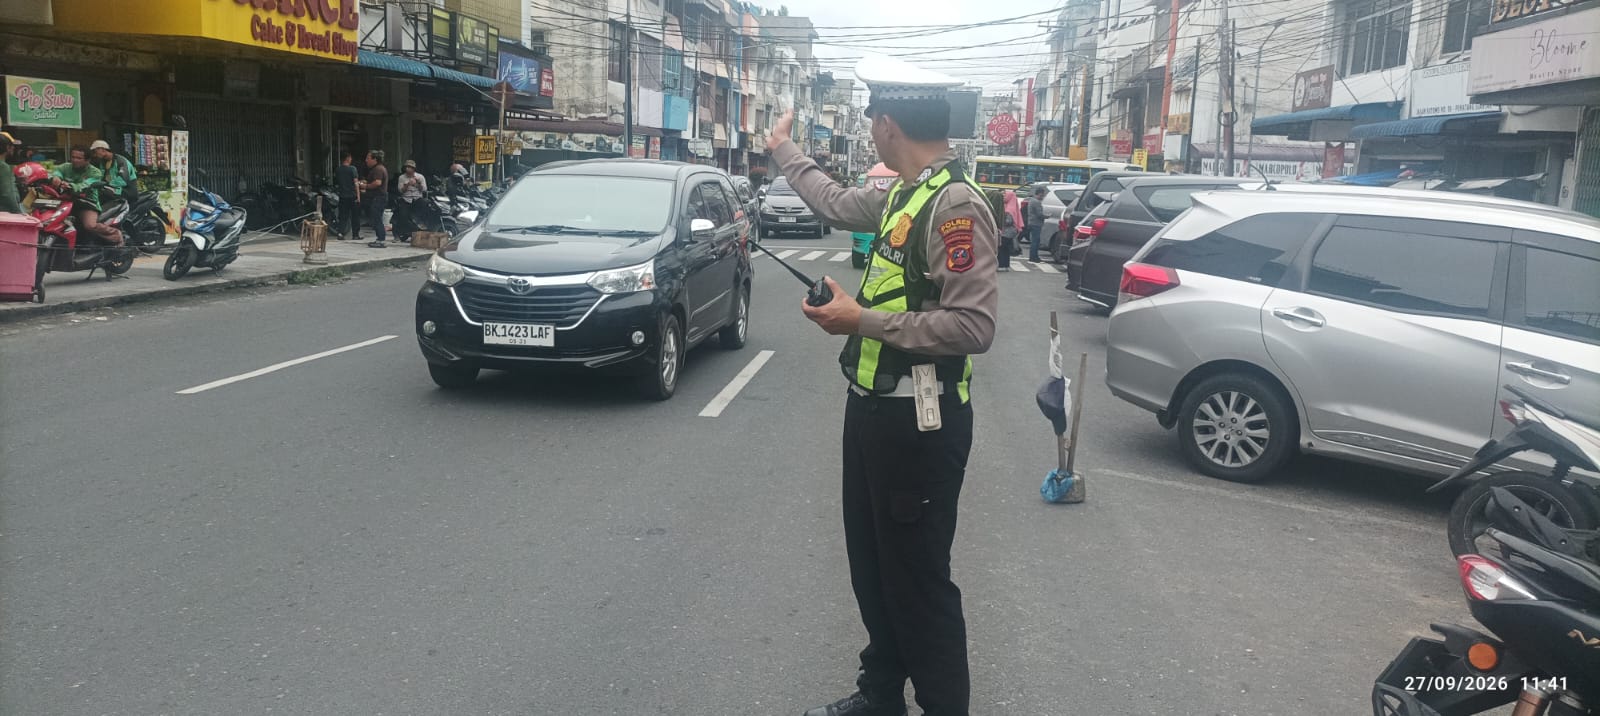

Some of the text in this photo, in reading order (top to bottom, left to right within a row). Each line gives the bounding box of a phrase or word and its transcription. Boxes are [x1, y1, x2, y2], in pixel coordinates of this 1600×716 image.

[251, 14, 283, 44] Cake
[297, 23, 330, 54] Bread
[332, 31, 358, 62] Shop
[1528, 29, 1587, 70] Bloome
[15, 83, 74, 111] Pie Susu
[941, 219, 970, 232] POLRES
[879, 242, 904, 264] POLRI
[484, 324, 551, 339] BK 1423 LAF
